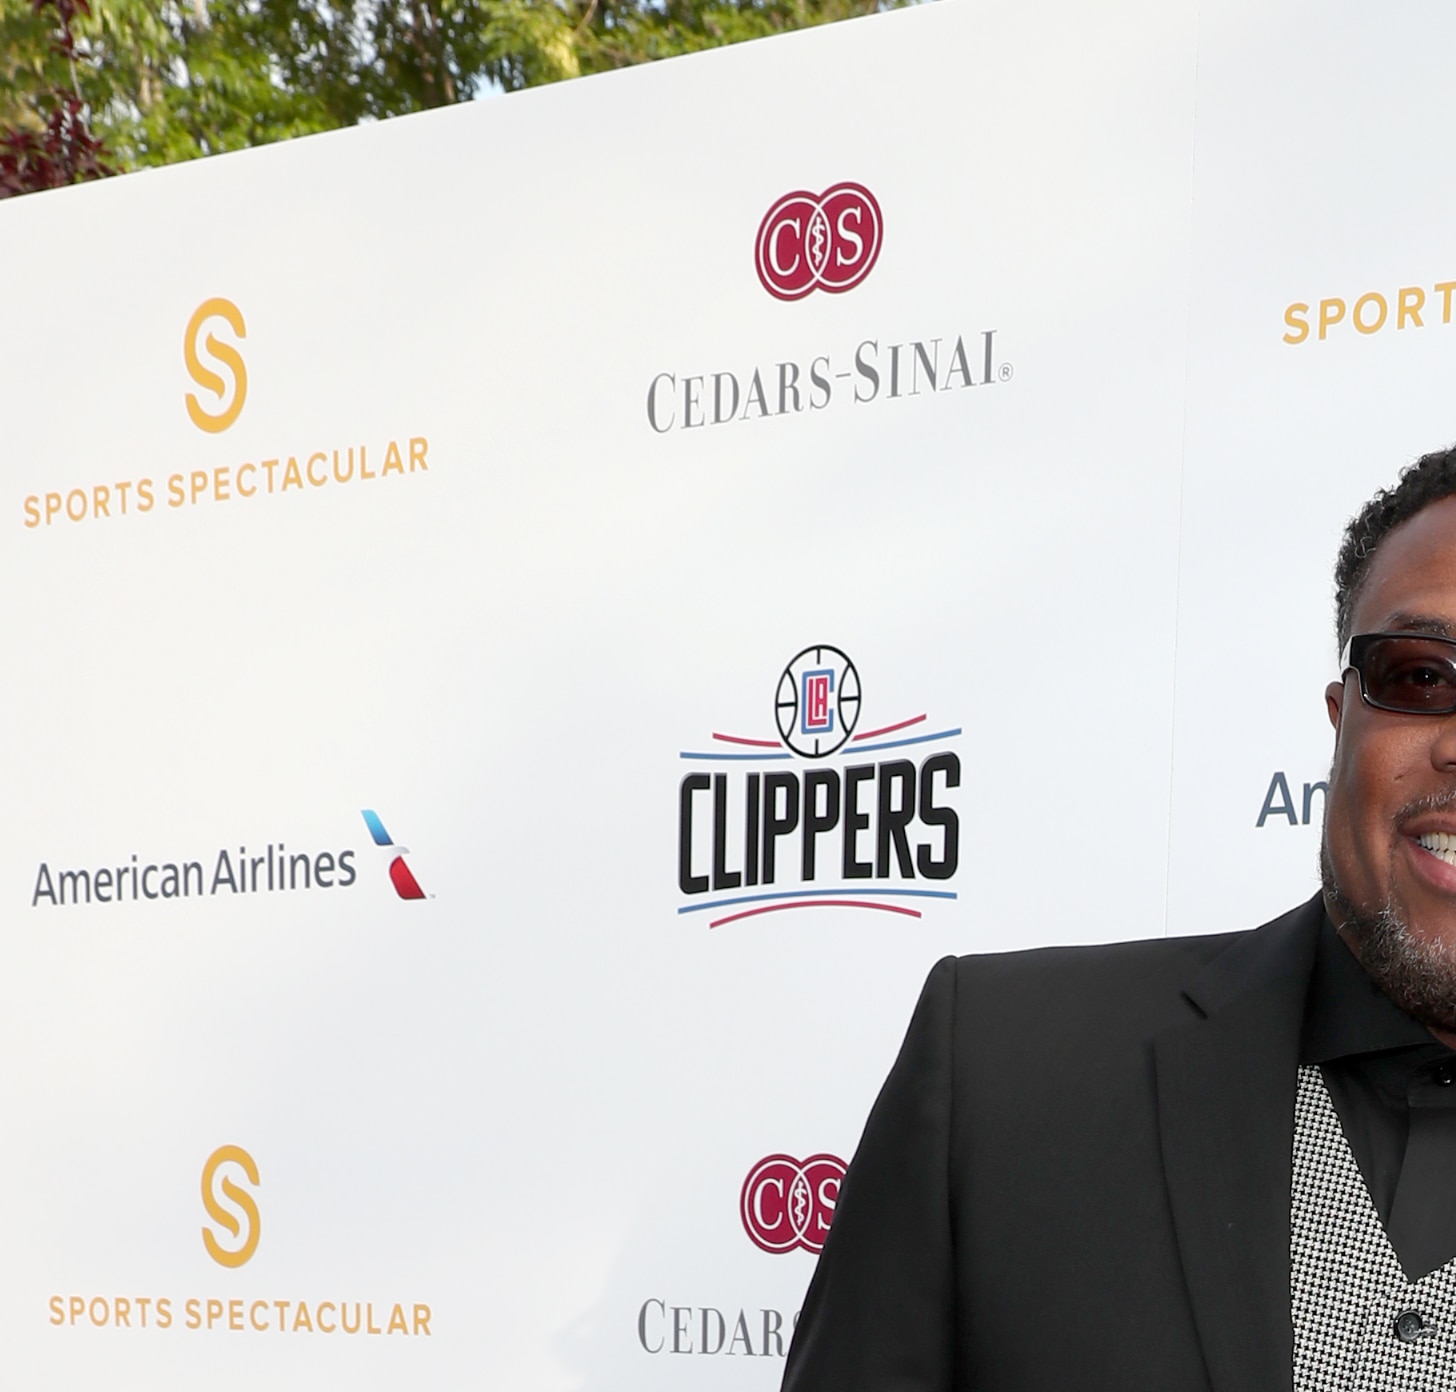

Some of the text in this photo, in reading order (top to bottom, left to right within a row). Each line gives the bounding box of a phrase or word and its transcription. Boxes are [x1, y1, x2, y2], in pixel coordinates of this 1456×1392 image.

[23, 436, 430, 529] SPORTS SPECTACULAR
[678, 750, 961, 896] CLIPPERS
[31, 842, 357, 908] American Airlines
[48, 1295, 432, 1336] SPORTS SPECTACULAR
[637, 1297, 802, 1358] CEDAR
